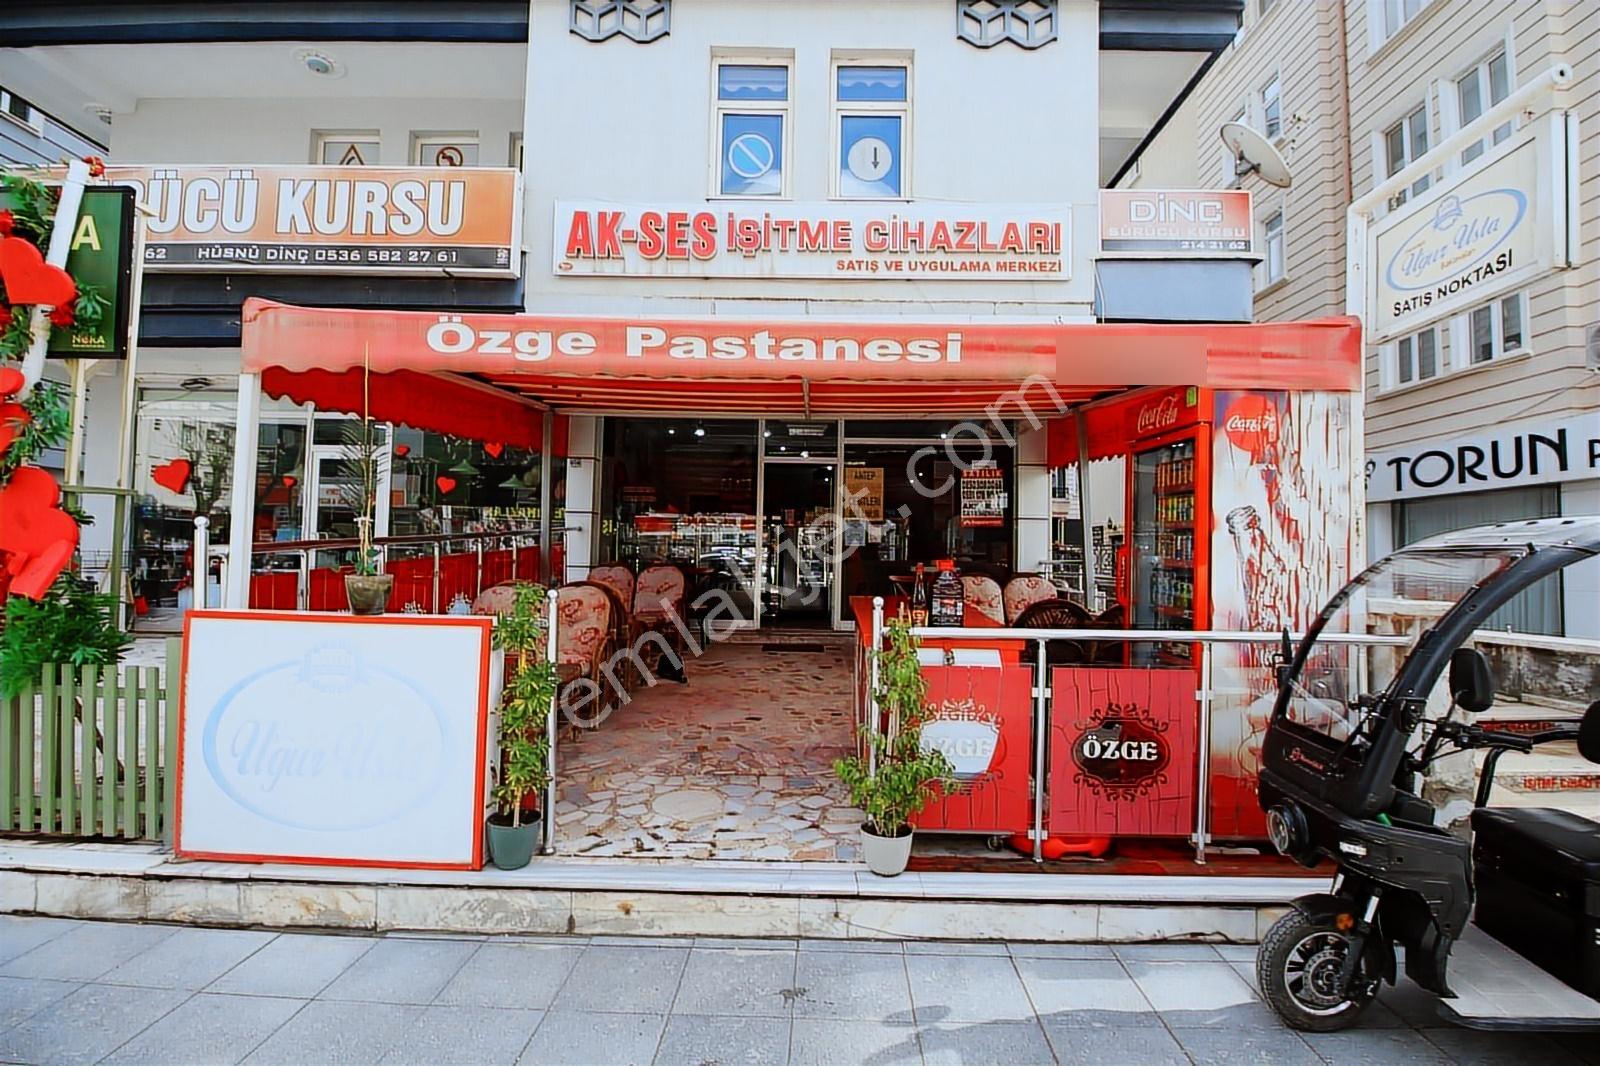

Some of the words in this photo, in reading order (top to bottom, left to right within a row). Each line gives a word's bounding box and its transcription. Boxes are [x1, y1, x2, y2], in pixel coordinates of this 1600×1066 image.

[275, 179, 466, 236] KURSU
[1129, 194, 1223, 226] DİNÇ
[198, 245, 260, 260] HÜSNÜ
[266, 246, 309, 265] DİNÇ
[315, 249, 361, 261] 0536
[368, 250, 401, 262] 582
[408, 250, 431, 262] 27
[437, 251, 458, 262] 61
[566, 211, 717, 260] AK-SES
[727, 212, 852, 258] İŞİTME
[864, 214, 1062, 255] CİHAZLARI
[1209, 241, 1223, 249] 21
[1228, 242, 1246, 250] 62
[836, 259, 879, 274] SATIŞ
[885, 260, 903, 272] VE
[908, 260, 990, 273] UYGULAMA
[996, 259, 1062, 273] MERKEZİ
[1393, 292, 1432, 317] SATIŞ
[1437, 248, 1512, 298] NOKTASI
[426, 316, 597, 362] Özge
[624, 326, 963, 364] Pastanesi
[1386, 428, 1568, 492] TORUN
[1083, 734, 1158, 761] ÖZGE
